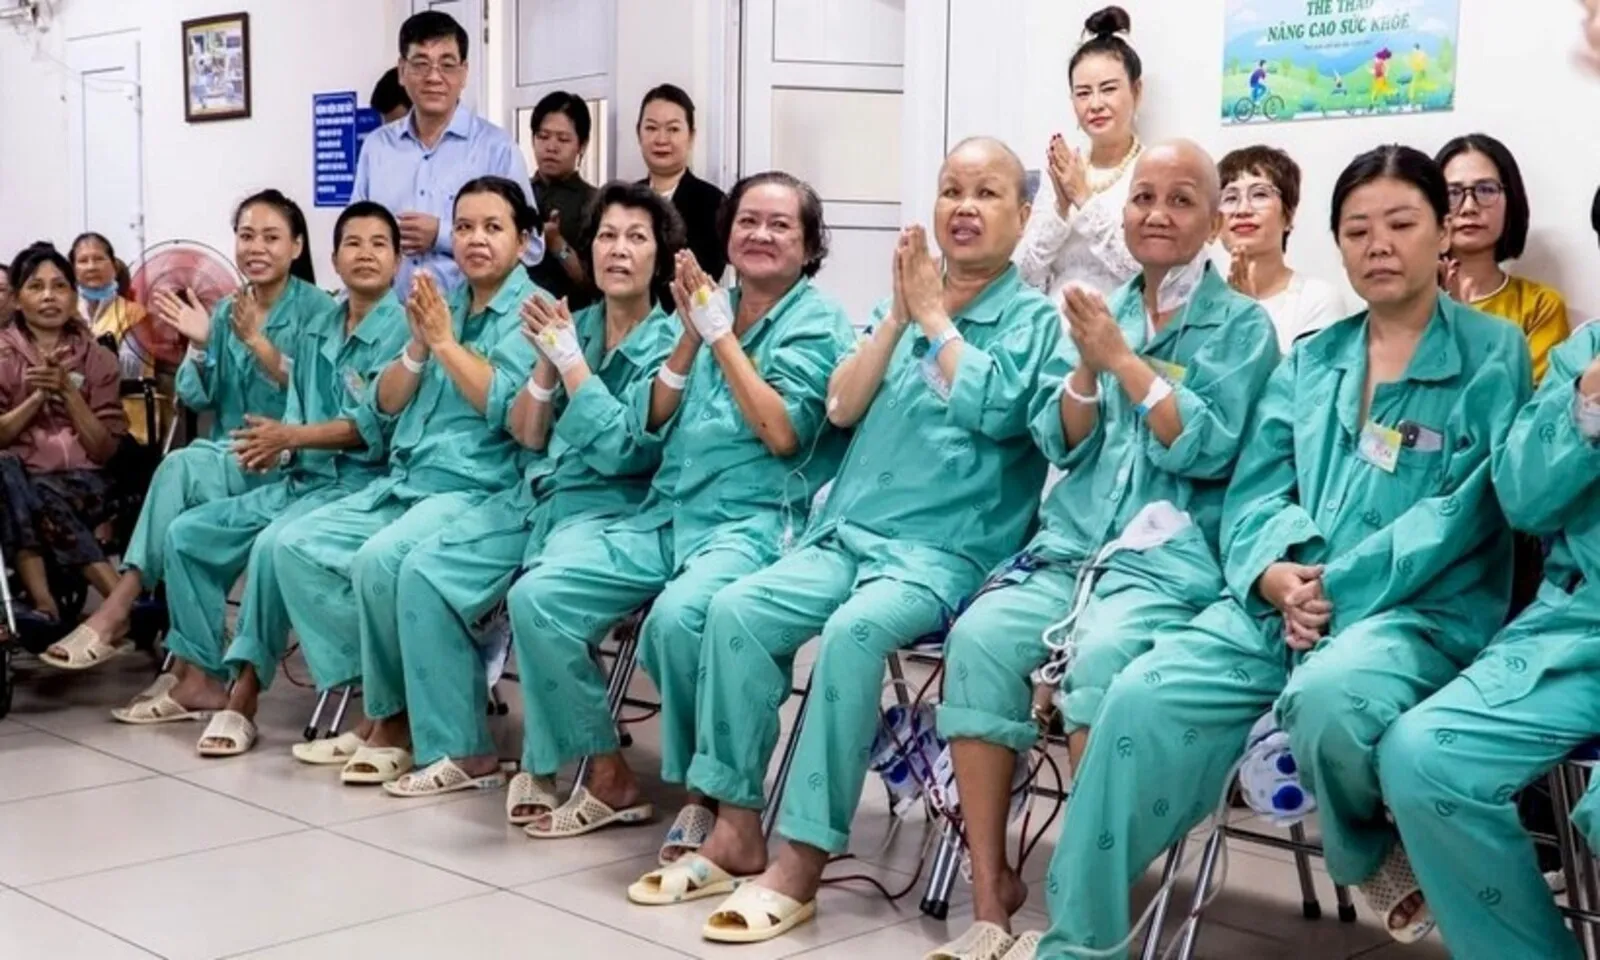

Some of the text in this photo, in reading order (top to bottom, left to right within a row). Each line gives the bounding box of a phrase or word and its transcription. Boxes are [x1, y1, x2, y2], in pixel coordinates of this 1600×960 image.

[1267, 21, 1305, 42] NÂNG
[1309, 21, 1336, 38] CAO
[1339, 15, 1366, 36] SỨC
